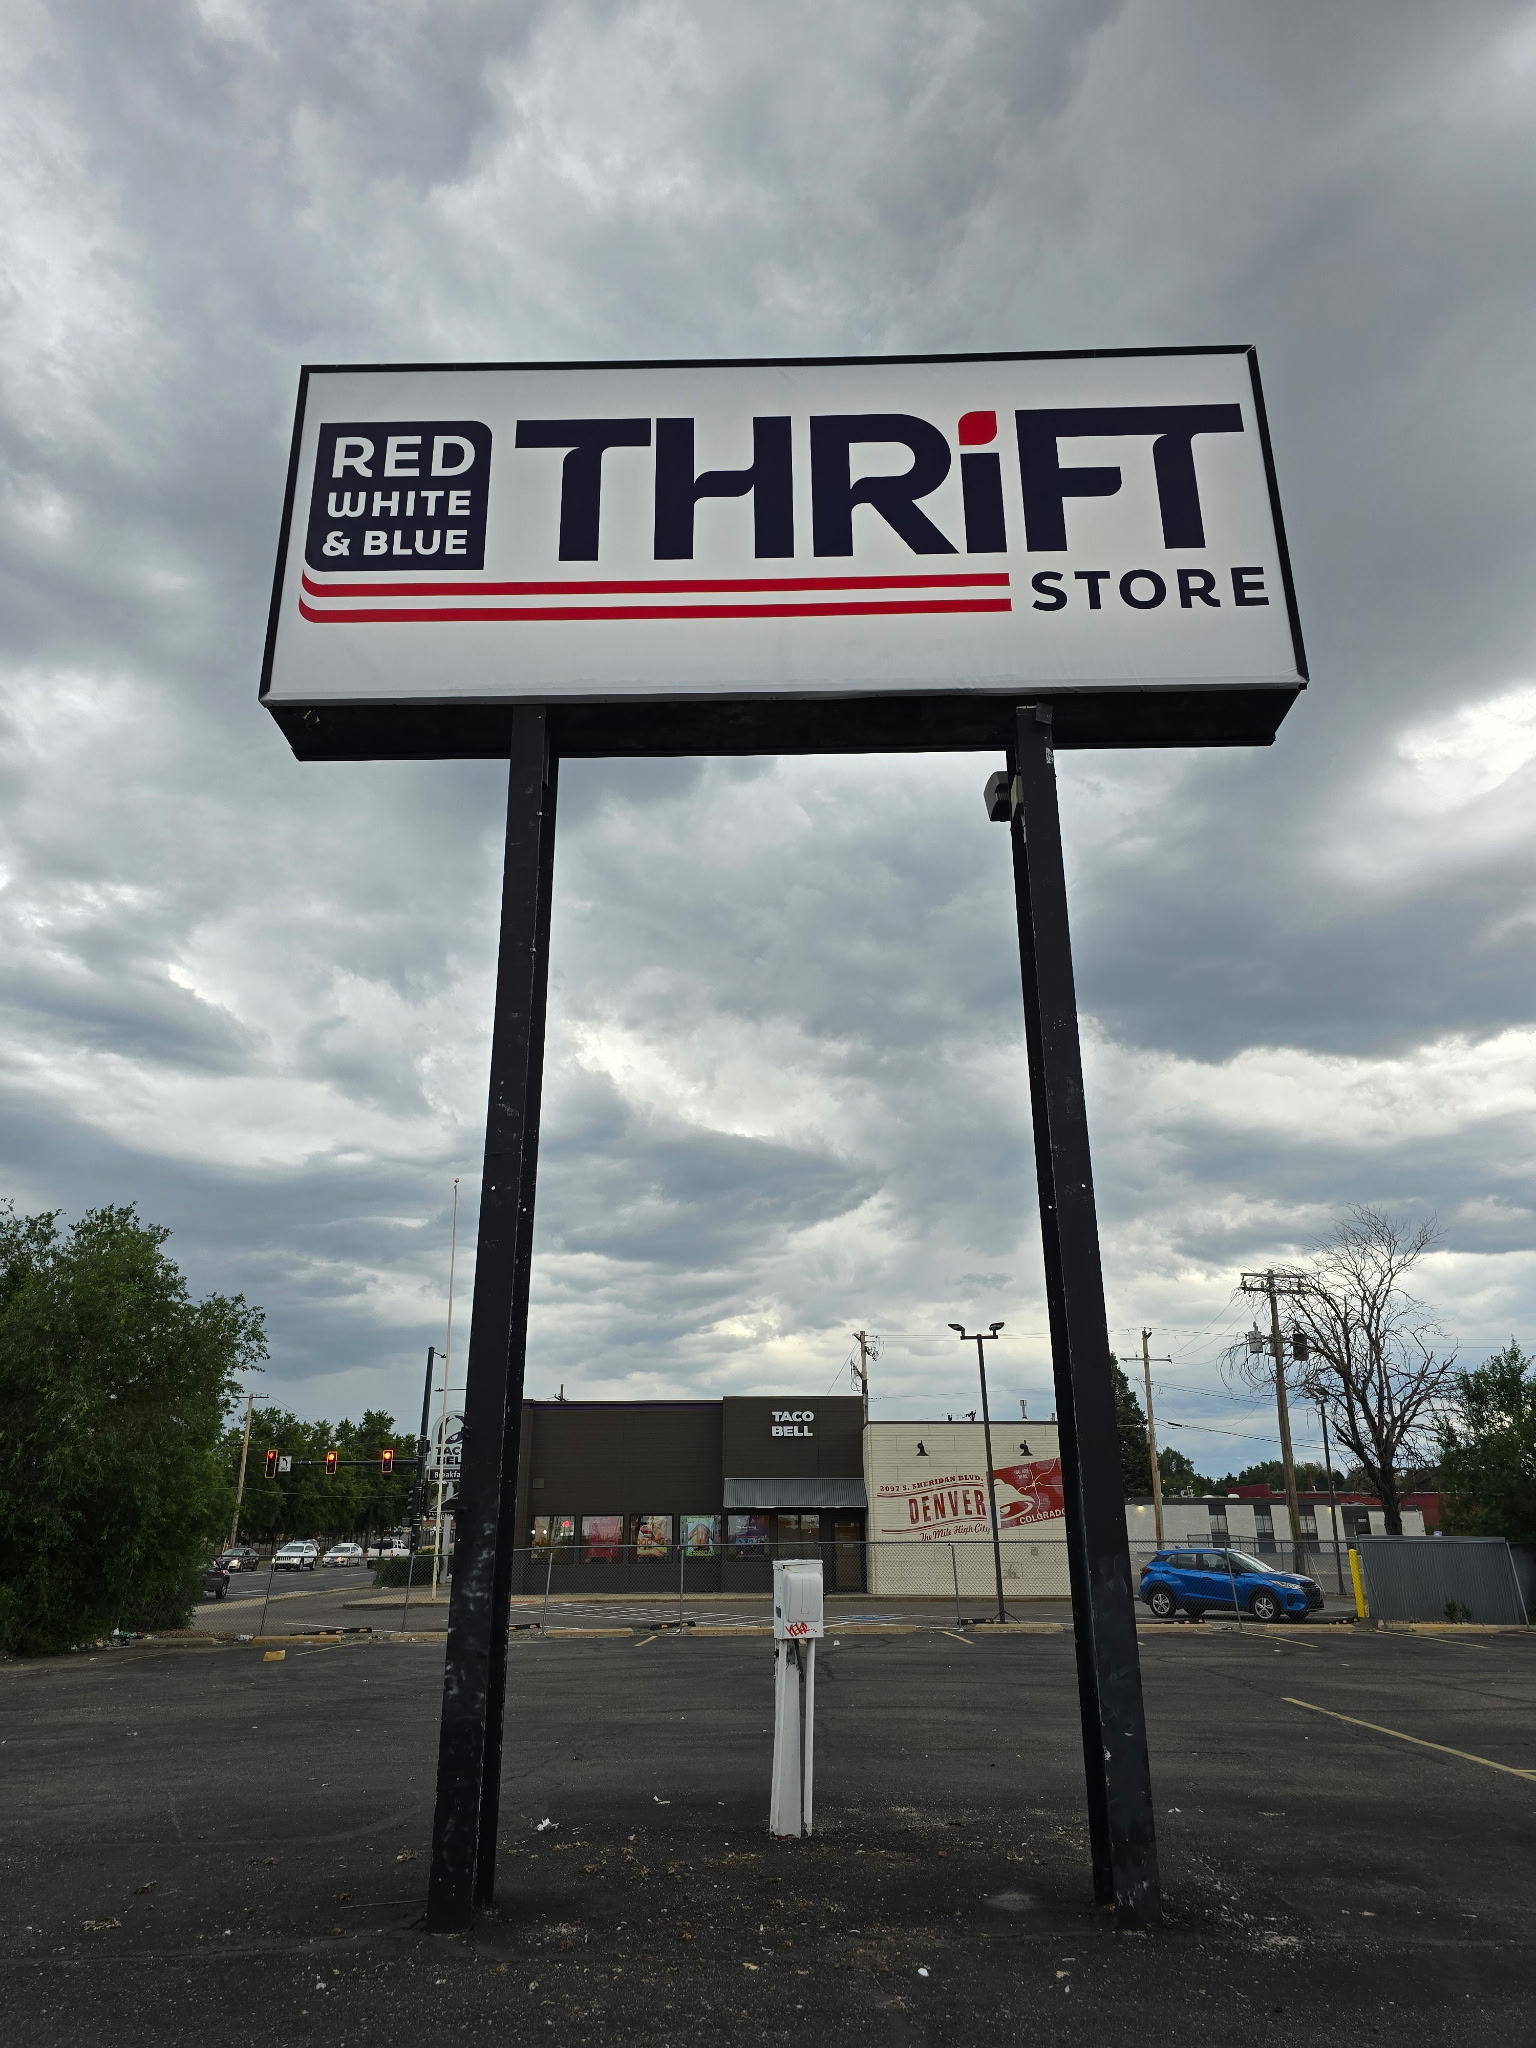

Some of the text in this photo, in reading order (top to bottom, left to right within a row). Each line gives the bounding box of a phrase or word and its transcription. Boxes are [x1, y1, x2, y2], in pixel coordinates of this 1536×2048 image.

[331, 435, 476, 478] RED
[327, 490, 472, 518] WHITE
[322, 529, 468, 556] & BLUE
[1031, 566, 1270, 612] STORE
[771, 1411, 815, 1422] TACO
[771, 1425, 814, 1437] BELL
[435, 1446, 461, 1456] TAC
[436, 1456, 462, 1465] BEL
[912, 1475, 956, 1490] SHERIDAN
[957, 1474, 984, 1482] BLVD.
[908, 1489, 987, 1525] DENVER
[919, 1522, 991, 1542] The Mile High City
